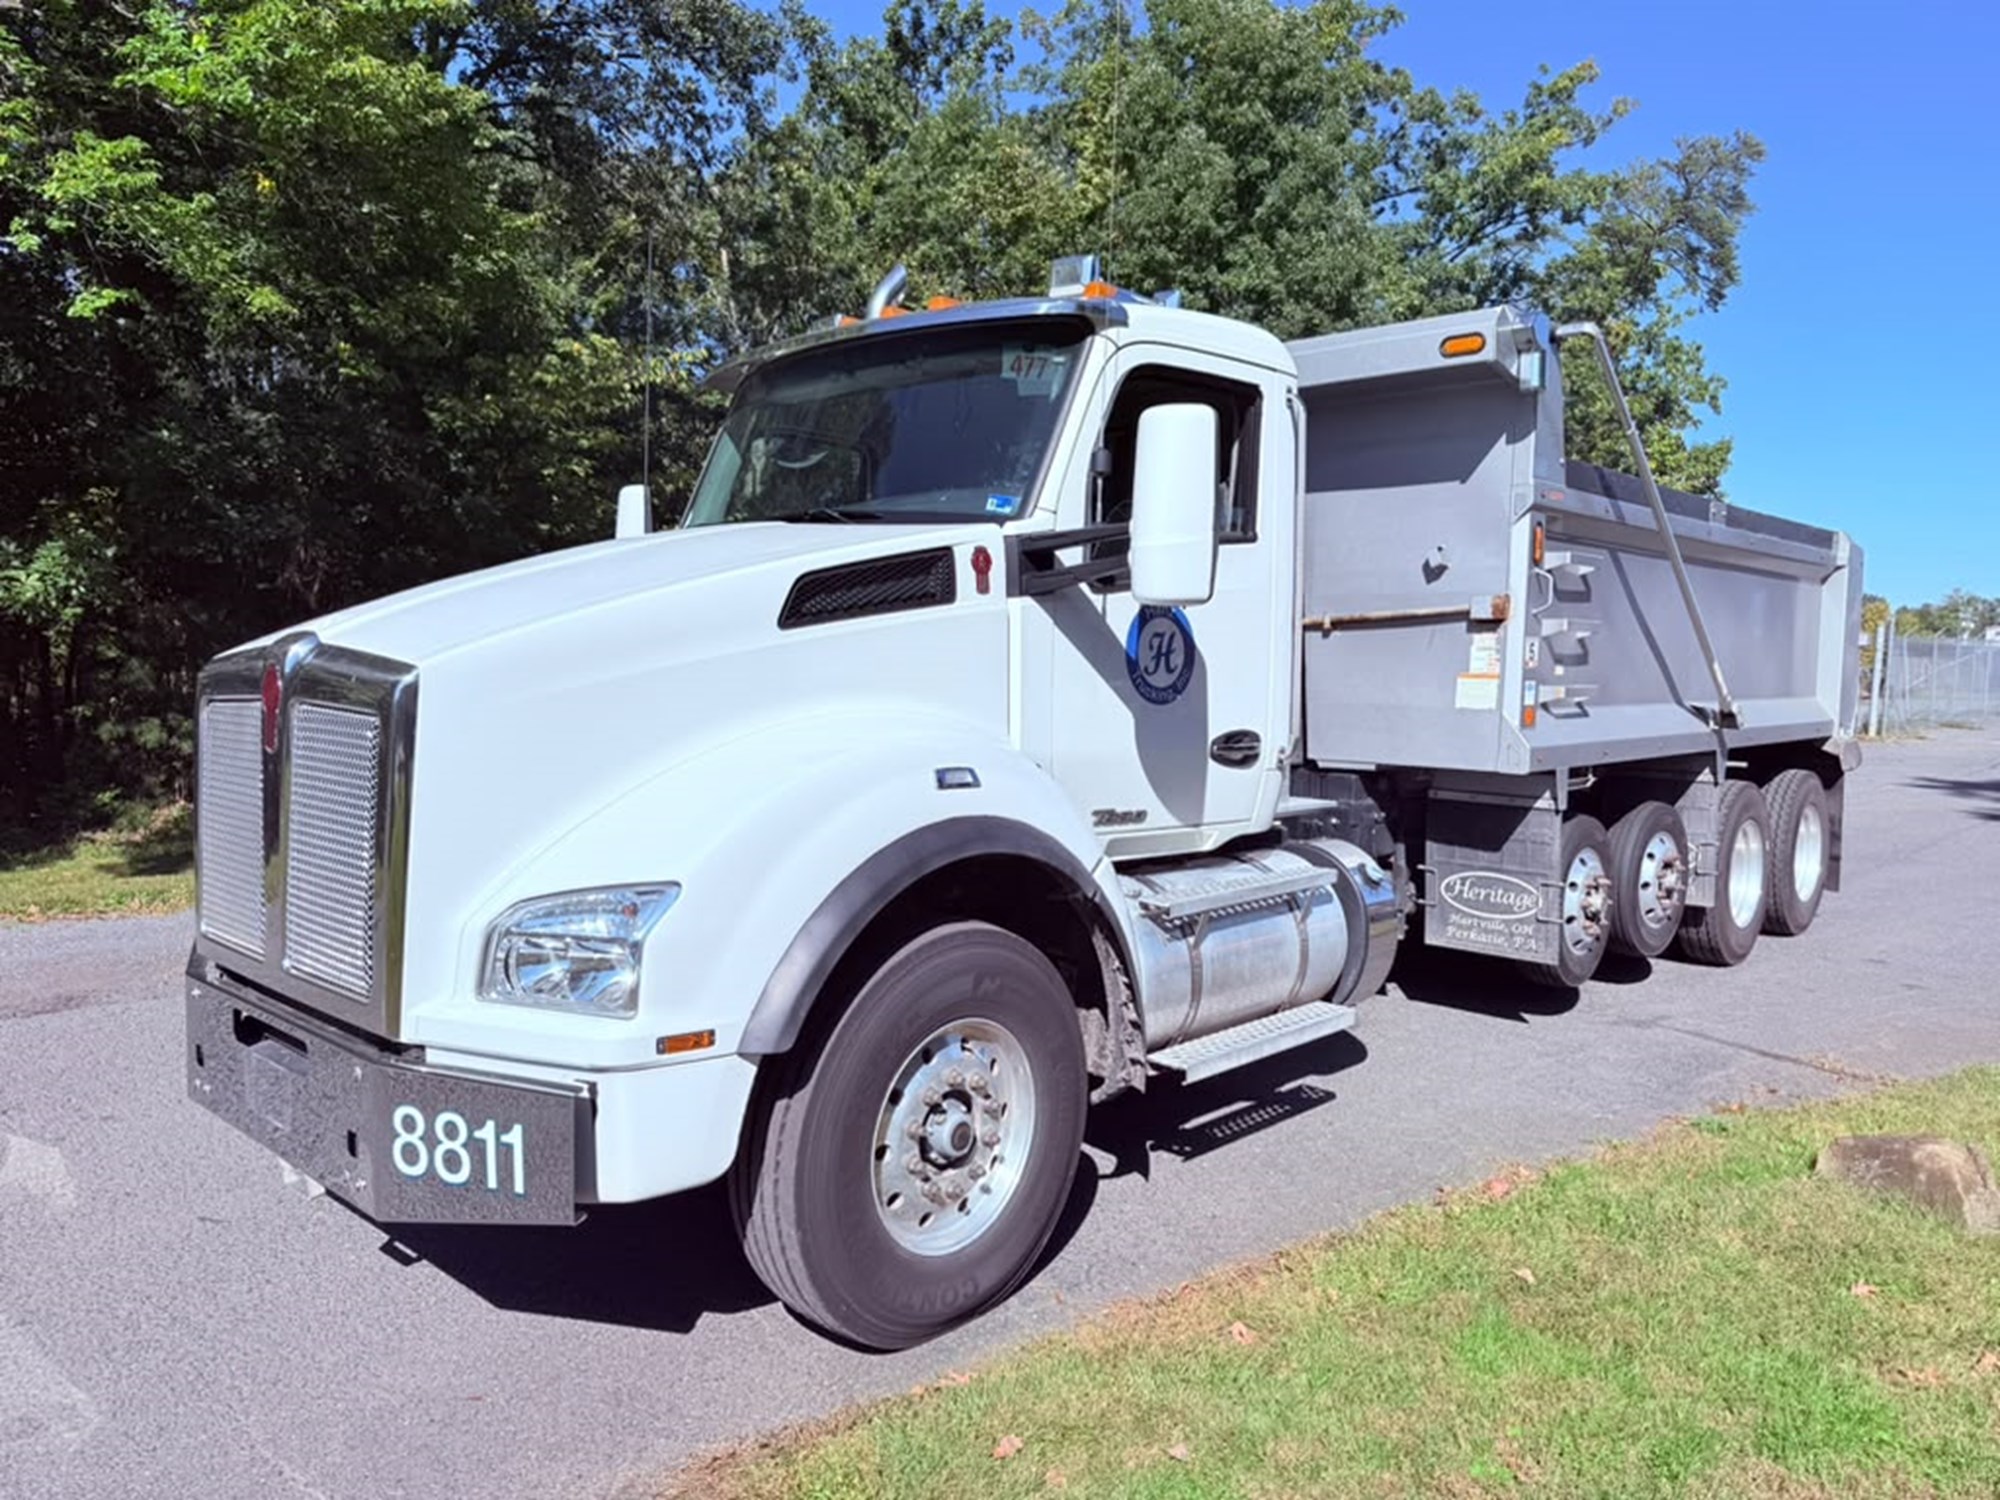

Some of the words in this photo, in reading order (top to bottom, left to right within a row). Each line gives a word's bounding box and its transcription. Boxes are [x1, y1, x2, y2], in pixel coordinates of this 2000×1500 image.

[1010, 354, 1048, 379] 477
[1143, 631, 1179, 677] H
[1447, 877, 1537, 912] Heritage
[1511, 922, 1535, 936] OH
[1513, 936, 1537, 951] PA
[392, 1104, 525, 1195] 8811
